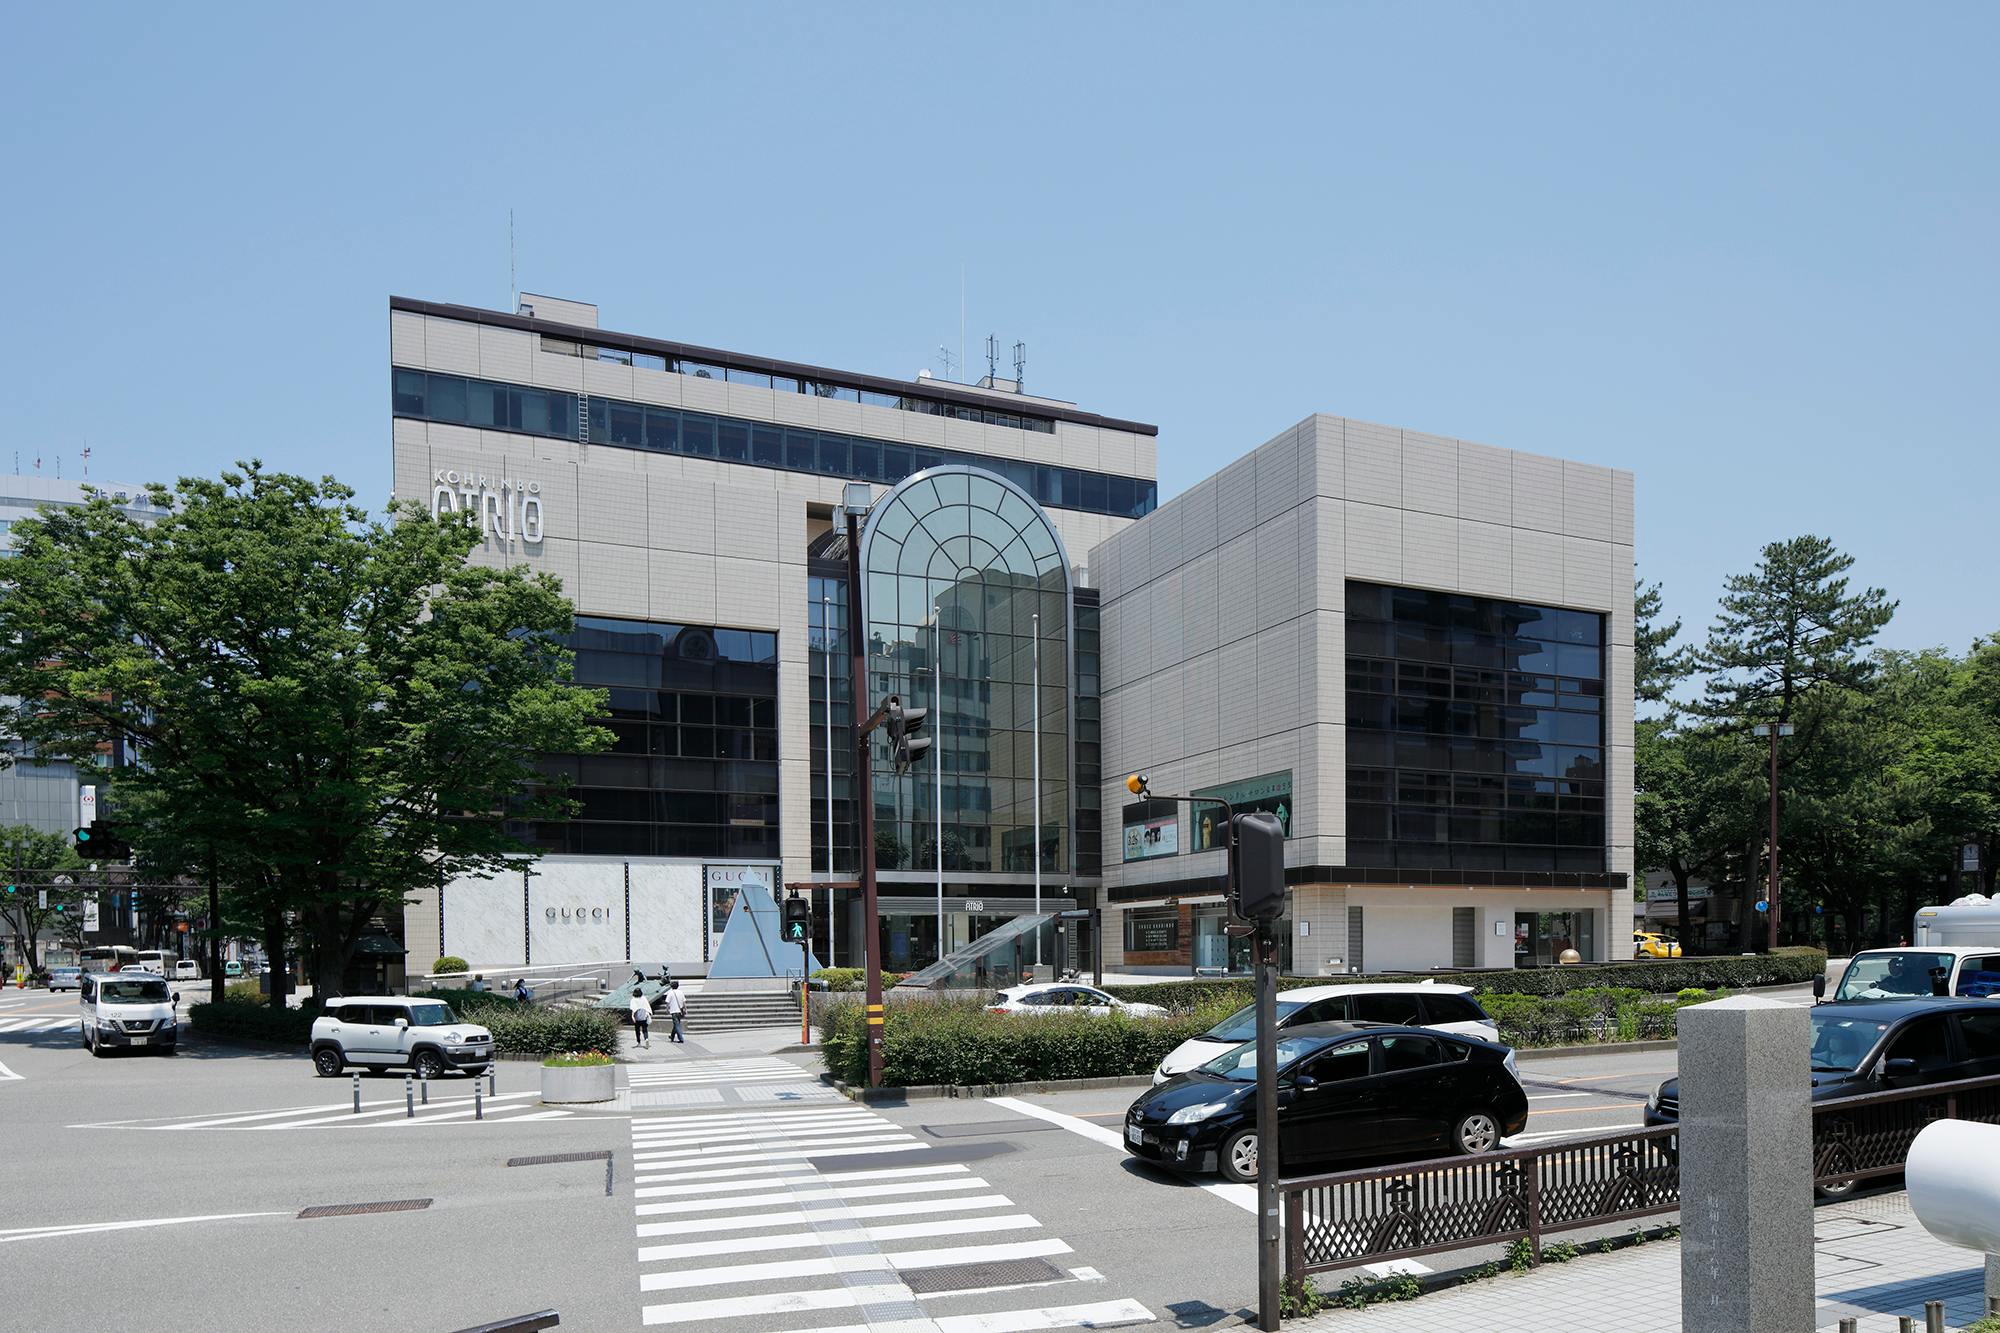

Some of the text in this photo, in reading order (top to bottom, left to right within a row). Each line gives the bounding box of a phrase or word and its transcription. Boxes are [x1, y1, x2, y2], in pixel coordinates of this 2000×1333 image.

[434, 469, 541, 493] KOHRINBO
[712, 871, 768, 881] GUCI
[545, 907, 610, 918] GUCCI
